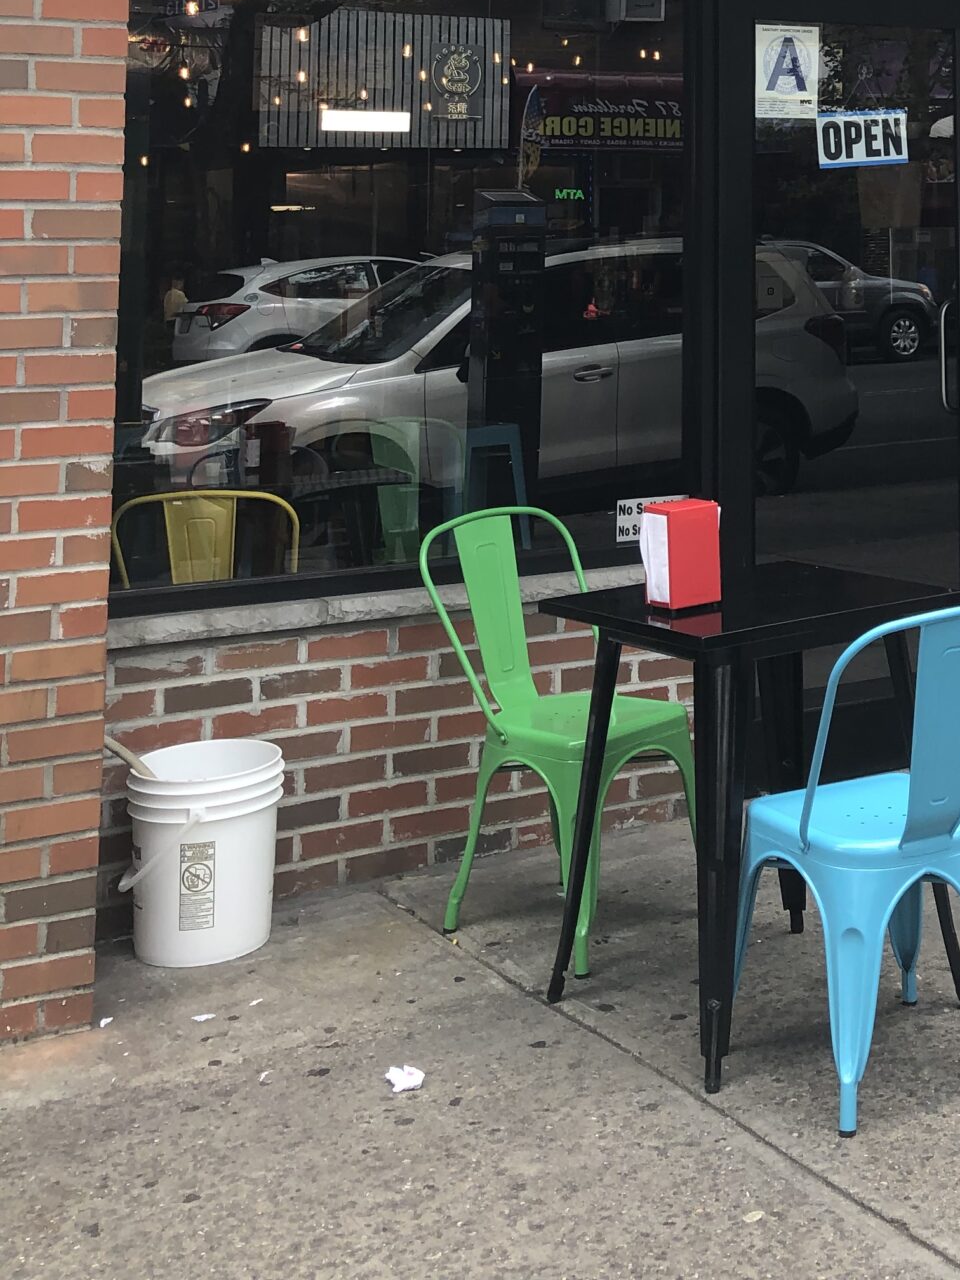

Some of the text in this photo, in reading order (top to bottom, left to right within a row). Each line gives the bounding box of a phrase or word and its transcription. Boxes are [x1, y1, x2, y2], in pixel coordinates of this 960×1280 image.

[766, 37, 807, 92] A
[821, 116, 904, 162] OPEN
[618, 503, 633, 516] No
[618, 525, 630, 537] No
